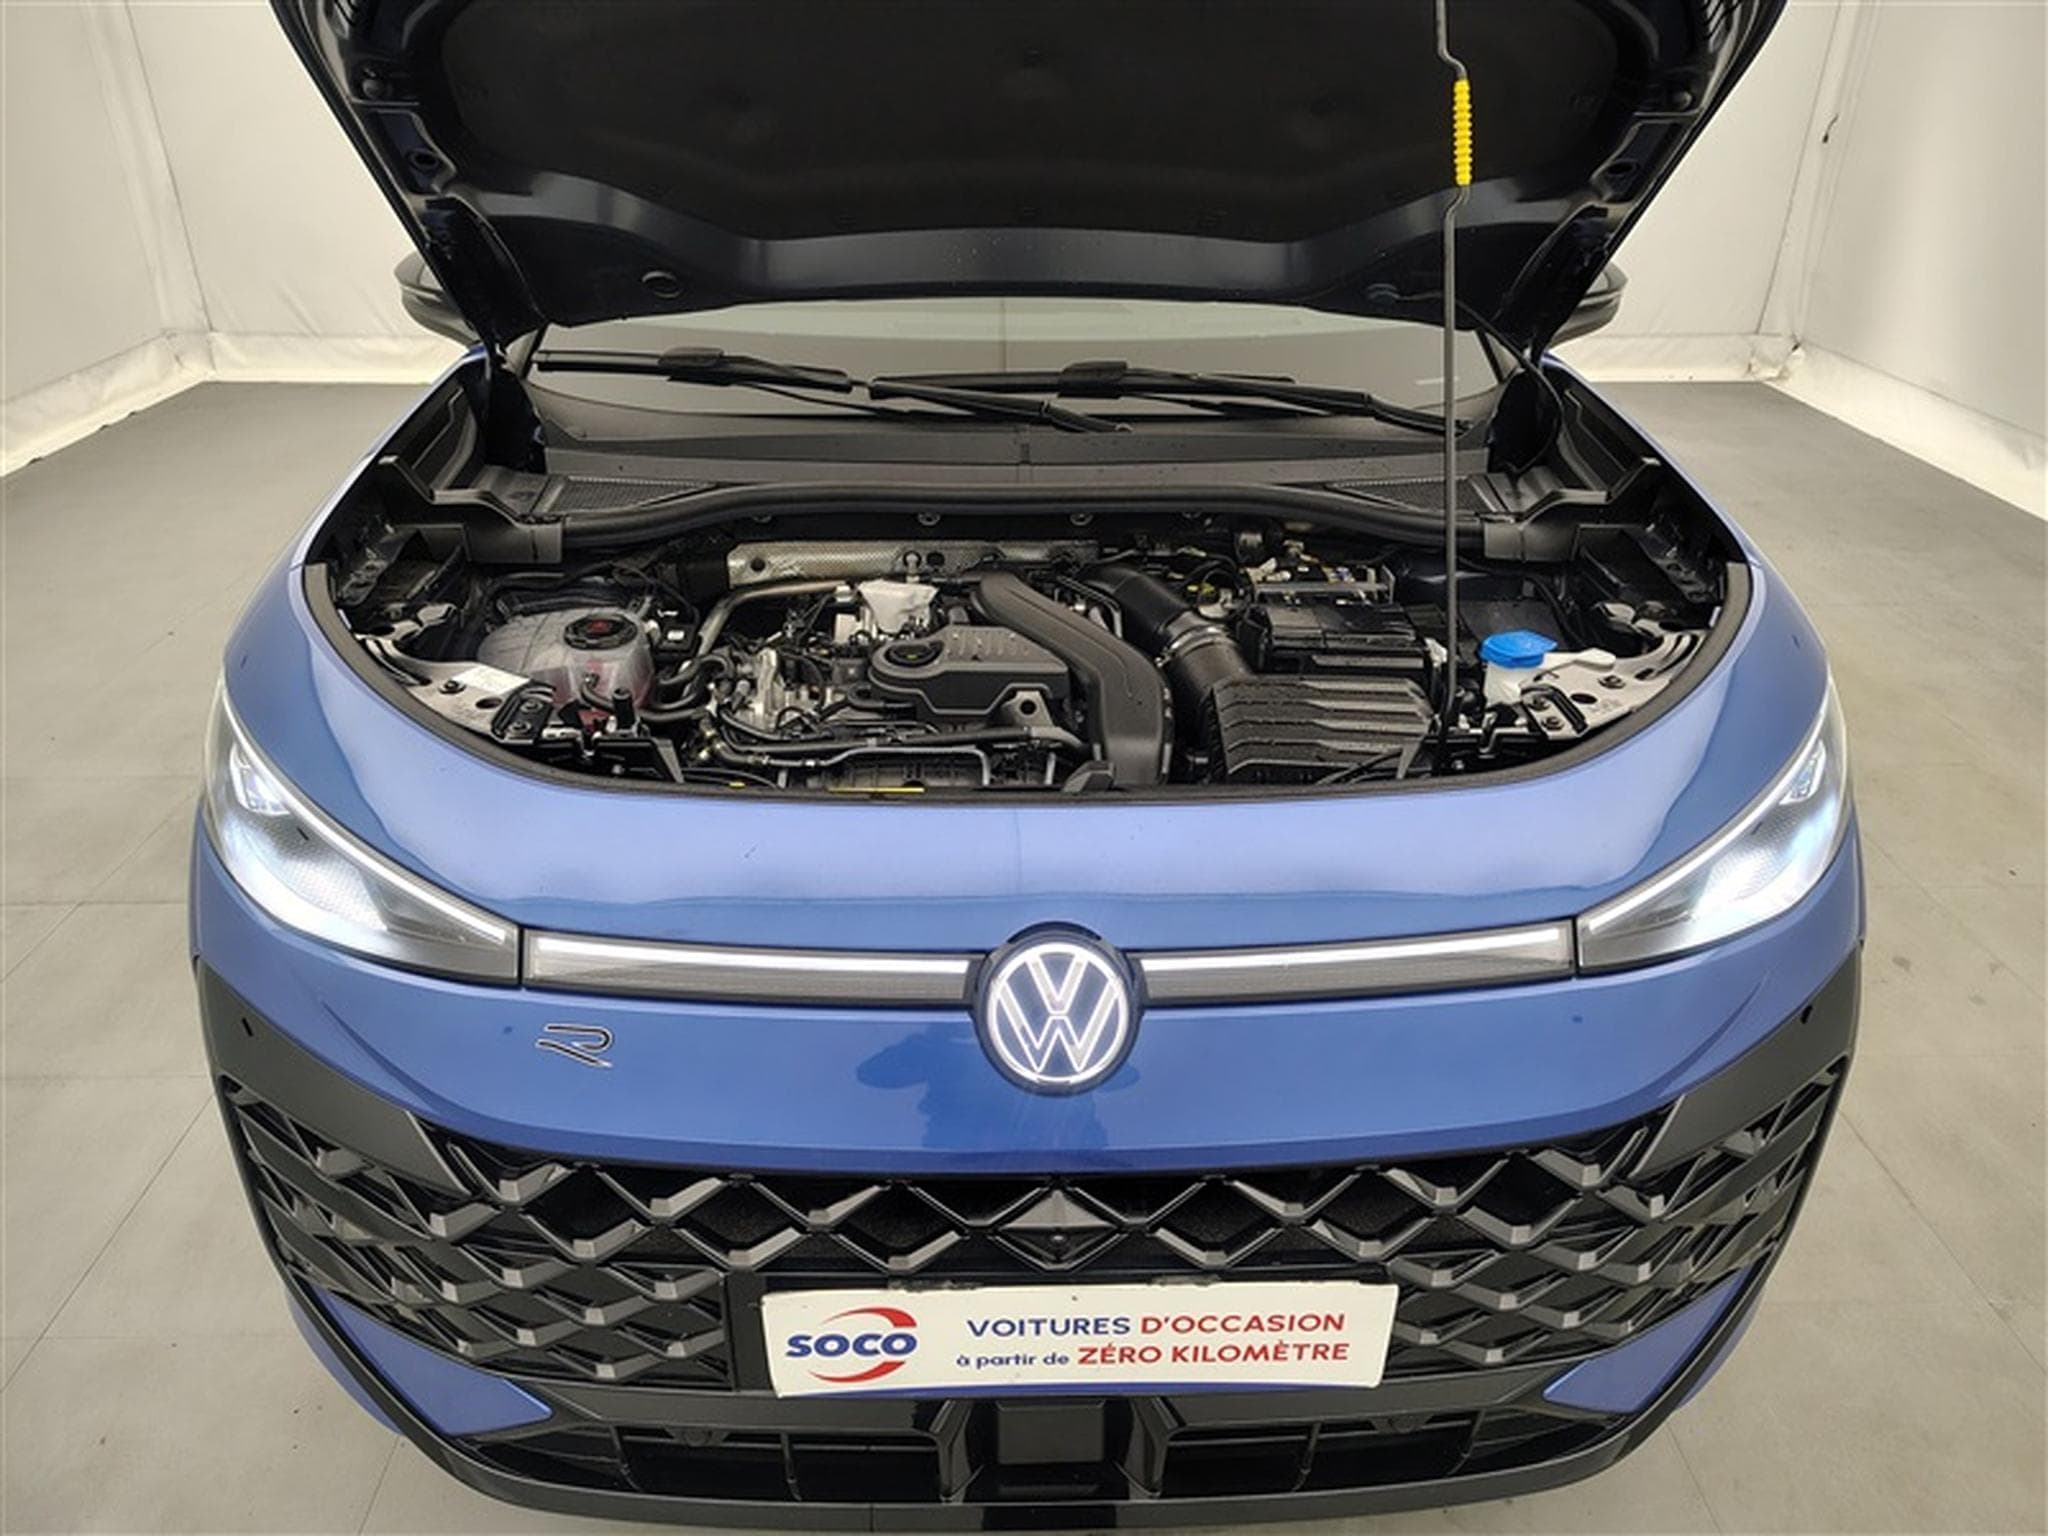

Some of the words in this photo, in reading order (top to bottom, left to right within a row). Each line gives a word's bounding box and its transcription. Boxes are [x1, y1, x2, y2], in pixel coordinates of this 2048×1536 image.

[995, 948, 1124, 1076] VW
[967, 1317, 1131, 1337] VOITURES
[1140, 1314, 1345, 1334] D'OCCASION
[786, 1332, 918, 1358] SOCO
[956, 1353, 970, 1367] à
[976, 1353, 1037, 1369] partir
[1043, 1352, 1070, 1366] de
[1077, 1342, 1163, 1365] ZÉRO
[1170, 1340, 1351, 1363] KILOMÈTRE
